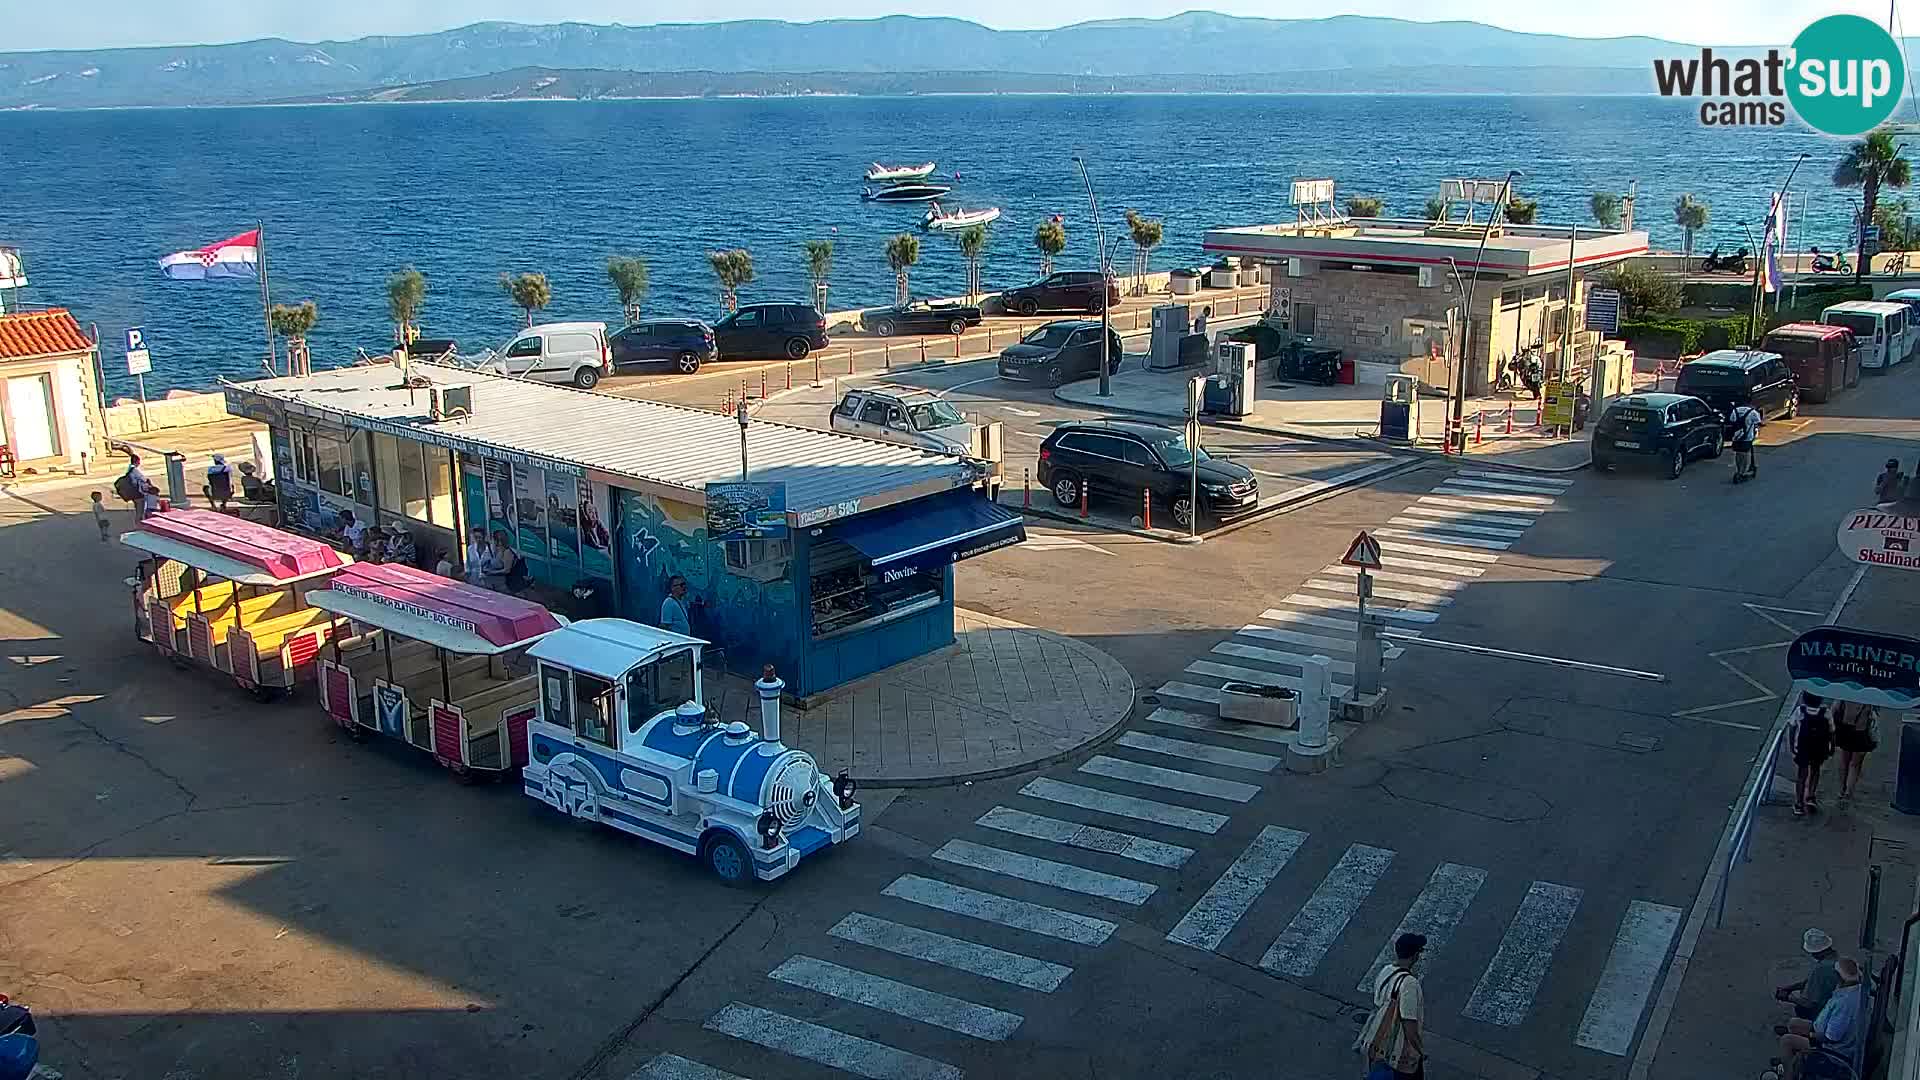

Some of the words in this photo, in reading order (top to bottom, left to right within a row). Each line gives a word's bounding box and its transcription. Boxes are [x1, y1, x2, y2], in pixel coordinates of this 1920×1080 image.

[128, 330, 142, 349] P
[395, 427, 435, 443] AUTOBUSNA
[436, 437, 467, 452] POSTAJA
[478, 445, 492, 457] BUS
[493, 448, 526, 465] STATION
[528, 456, 553, 471] TICKET
[555, 463, 582, 477] OFFICE
[1847, 514, 1920, 532] PIZZE
[1000, 535, 1018, 546] CHOICE
[884, 565, 918, 583] iNovine
[334, 582, 346, 593] BOL
[346, 585, 369, 600] CENTER
[372, 594, 394, 608] BEACH
[394, 601, 416, 615] ZLATNI
[416, 606, 429, 619] RAT
[433, 612, 447, 625] BOL
[447, 617, 473, 631] CENTER
[1870, 664, 1896, 678] bar
